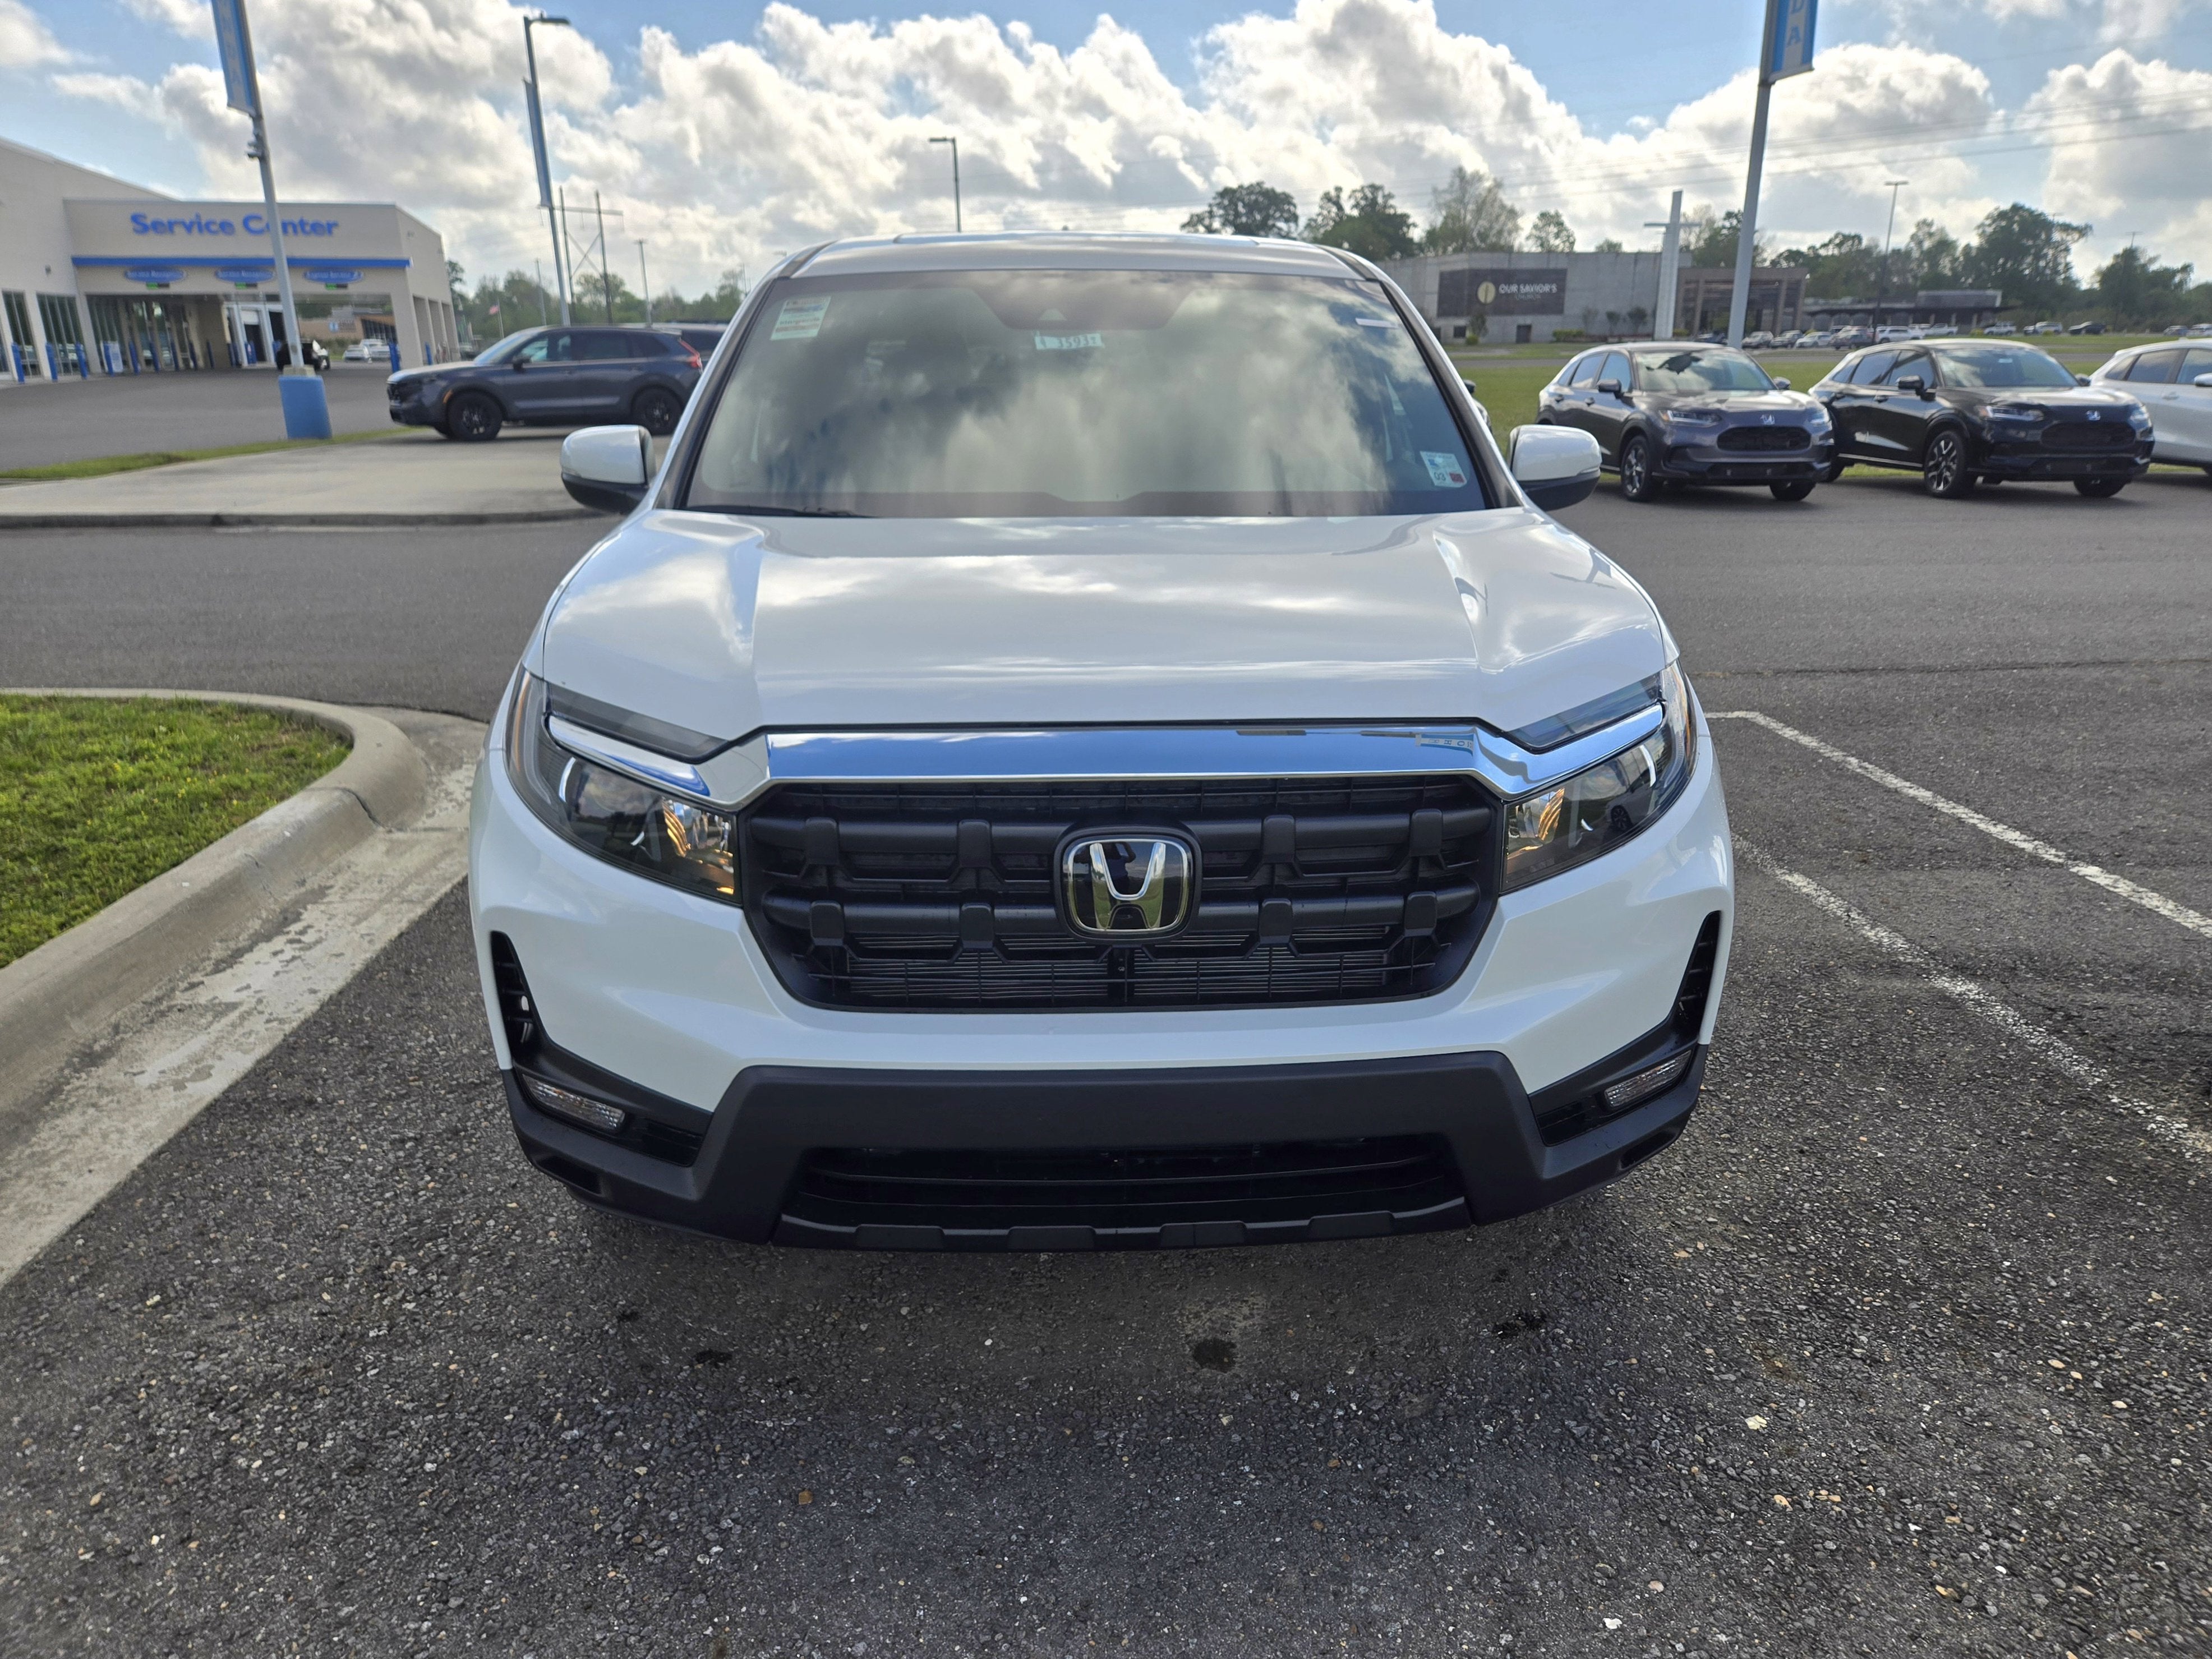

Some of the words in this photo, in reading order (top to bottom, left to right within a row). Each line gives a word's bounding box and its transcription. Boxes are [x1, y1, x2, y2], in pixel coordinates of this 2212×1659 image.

[130, 213, 236, 236] Service
[242, 213, 339, 236] Cnter
[1499, 283, 1518, 294] OUR
